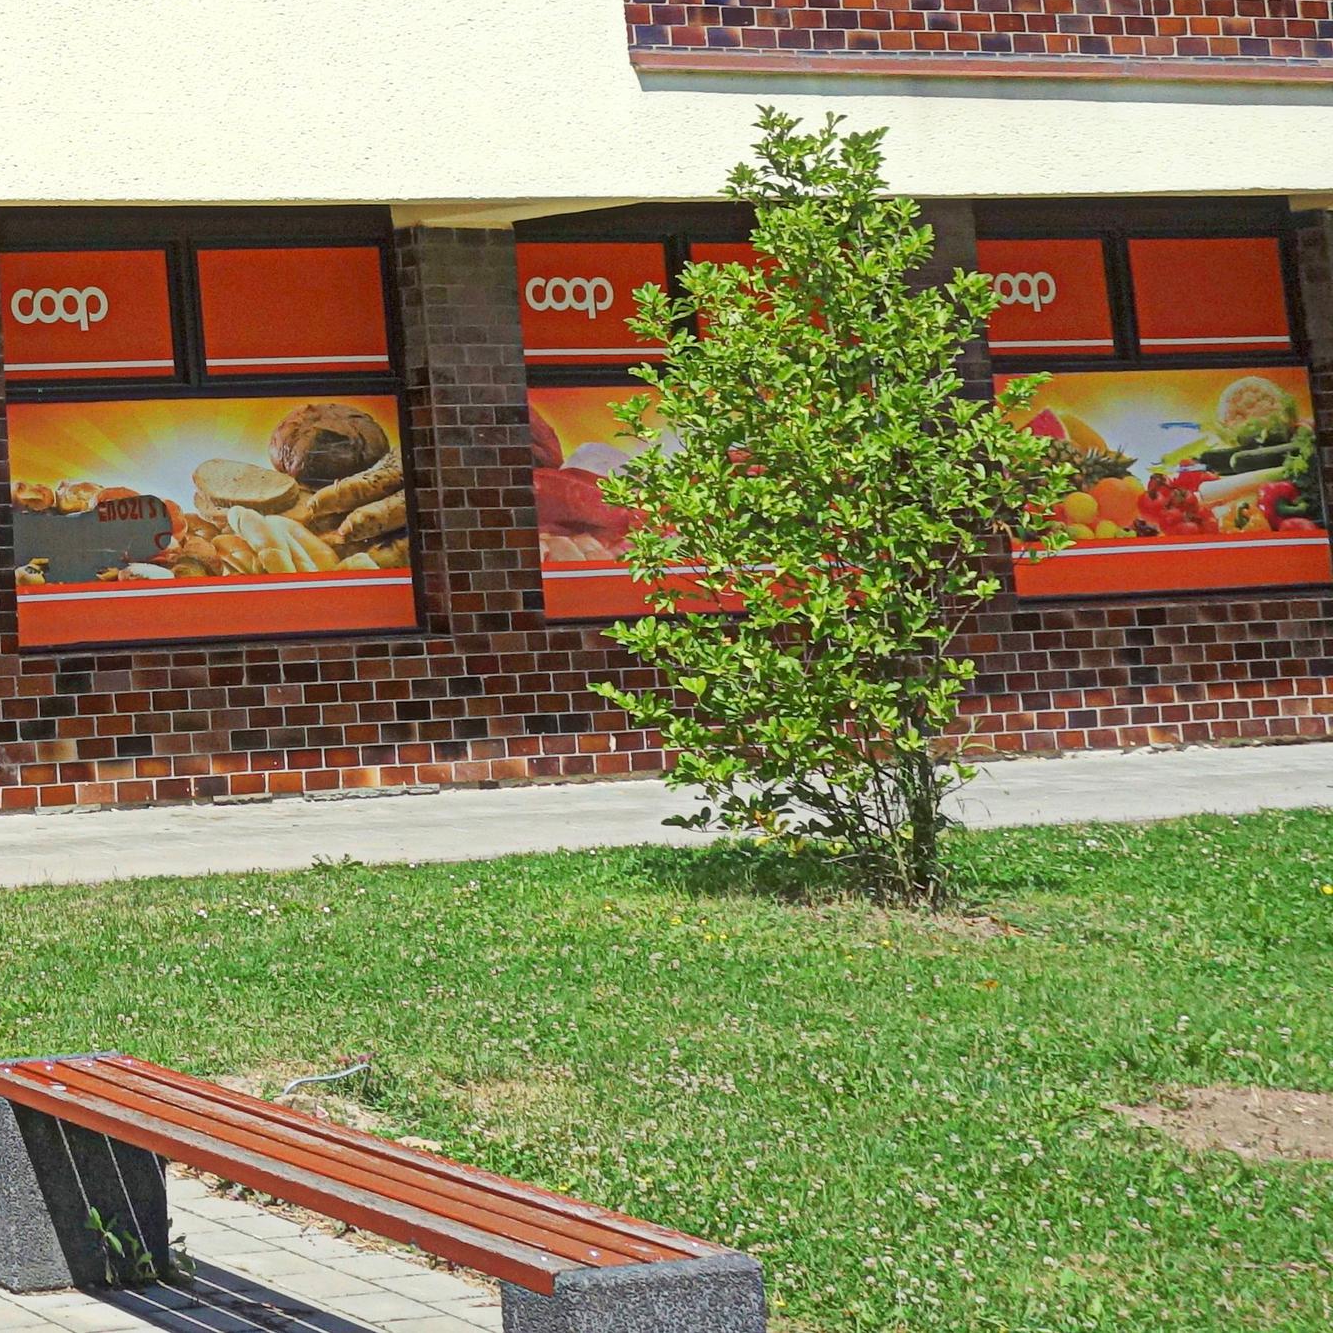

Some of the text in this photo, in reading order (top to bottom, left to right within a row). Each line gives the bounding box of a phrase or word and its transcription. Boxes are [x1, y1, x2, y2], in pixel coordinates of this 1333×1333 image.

[10, 286, 109, 331] coop
[525, 276, 614, 320] coop
[993, 271, 1057, 313] oop
